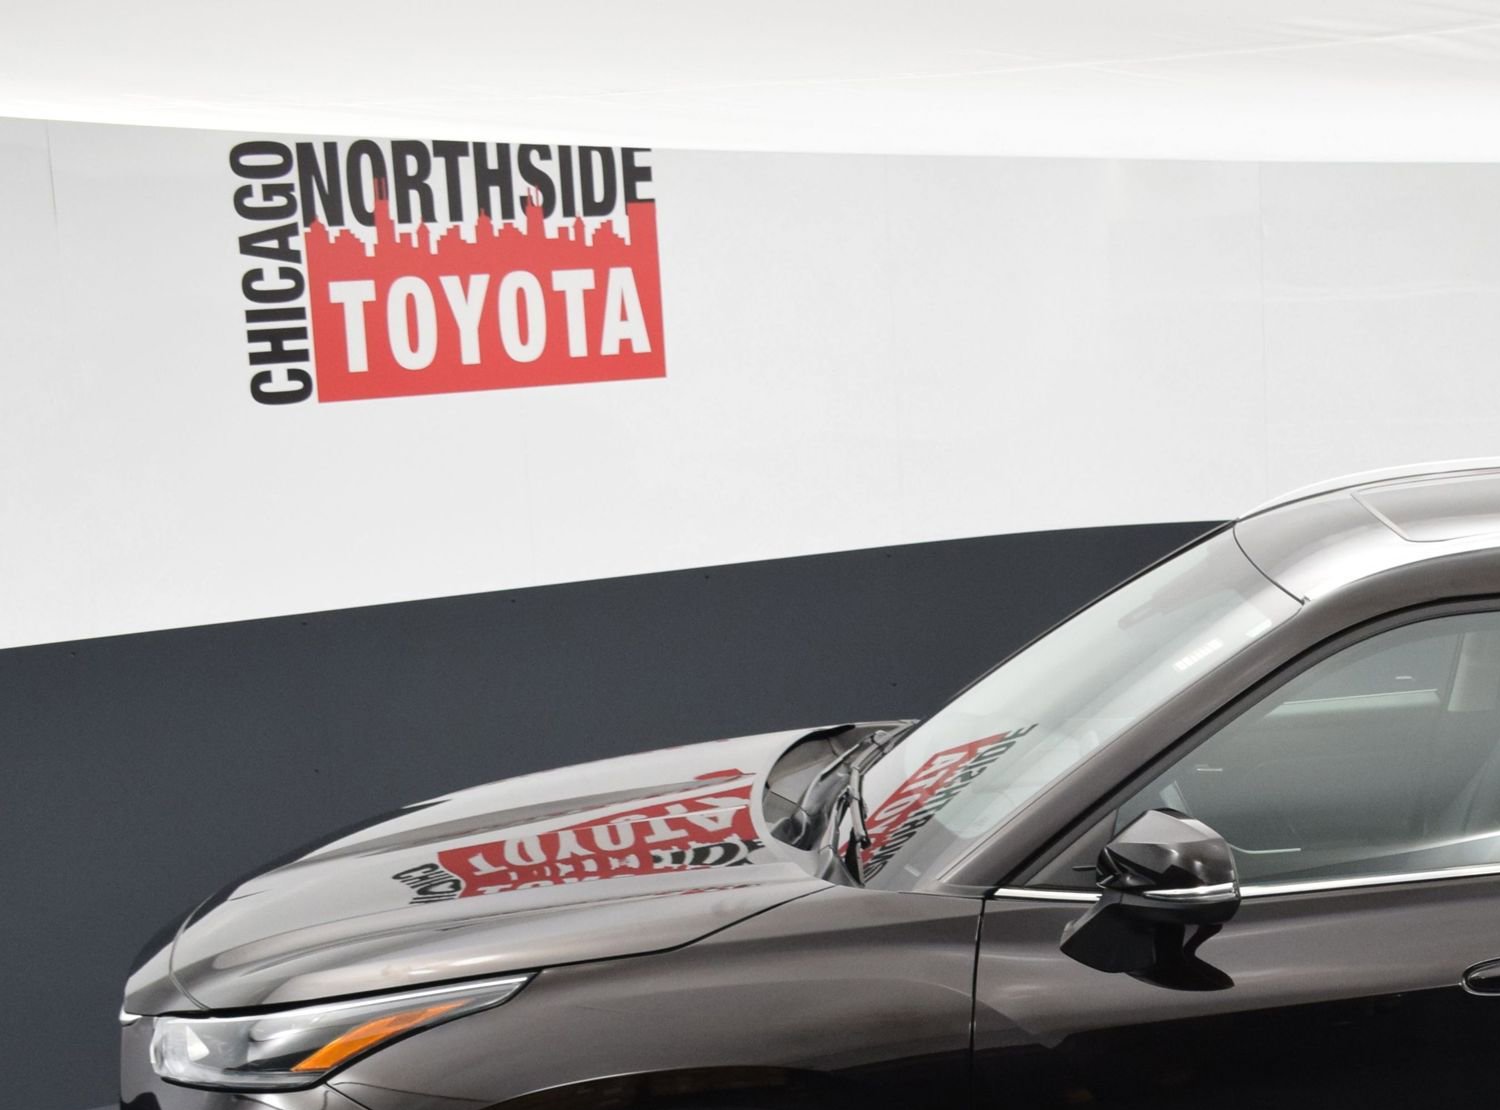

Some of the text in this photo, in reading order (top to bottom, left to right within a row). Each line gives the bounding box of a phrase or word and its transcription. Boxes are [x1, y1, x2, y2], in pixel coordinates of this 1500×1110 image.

[296, 139, 654, 228] NORTHSIDE
[229, 140, 313, 405] CHICAGO
[328, 266, 652, 374] TOYOTA
